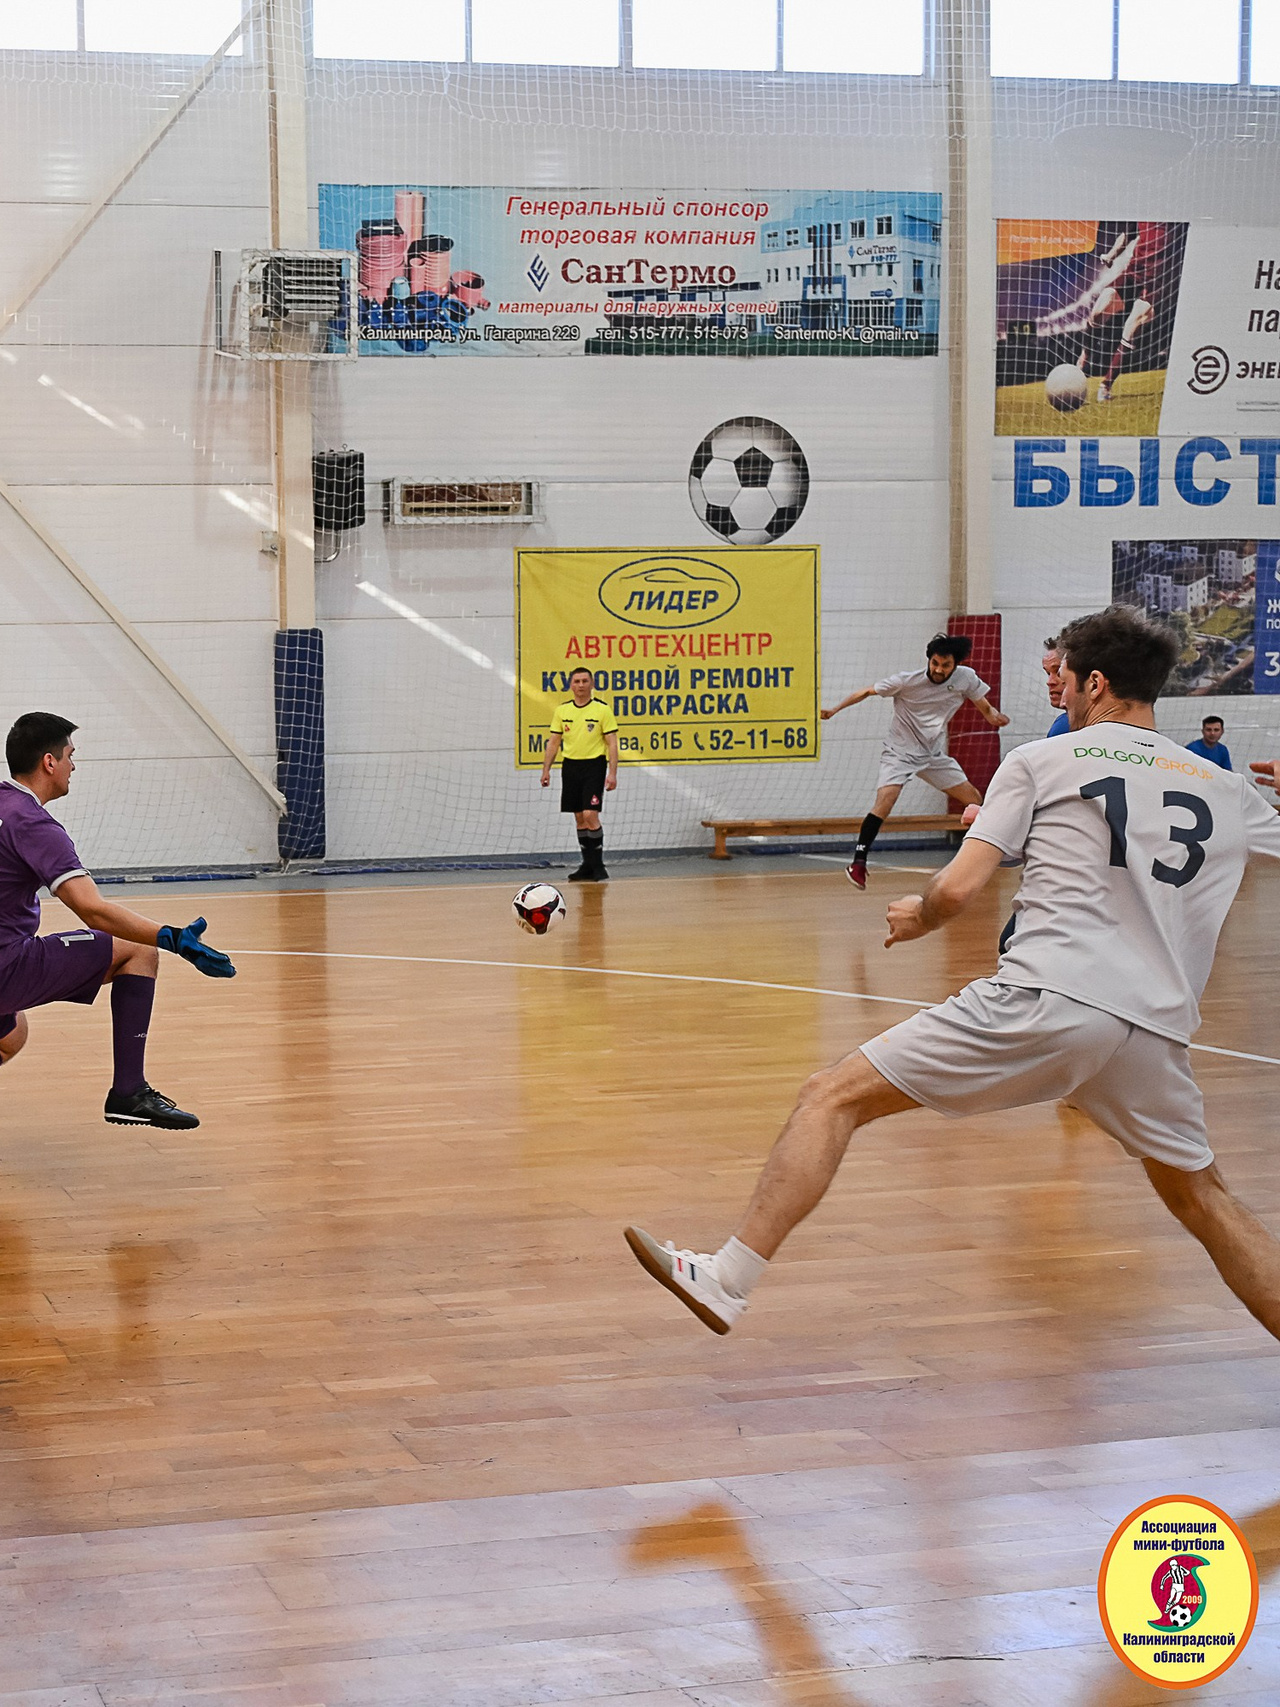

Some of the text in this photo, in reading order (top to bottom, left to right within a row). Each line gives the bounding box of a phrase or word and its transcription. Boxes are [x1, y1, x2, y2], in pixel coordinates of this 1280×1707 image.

[506, 196, 770, 220] Генеральный спонсор
[520, 228, 756, 248] торговая компания
[561, 258, 737, 291] СанТермо
[498, 298, 778, 317] материалы для наружных сетей
[485, 326, 551, 342] Гагарина
[553, 326, 580, 341] 229
[597, 327, 625, 341] тел.
[628, 326, 690, 342] 515-777,
[693, 326, 749, 341] 515-073
[773, 326, 919, 344] Santermo-KL@mail.ru
[1248, 309, 1280, 340] па
[1235, 361, 1280, 379] ЭНЕ
[1014, 436, 1280, 507] БЫСТ
[624, 589, 719, 613] ЛИДЕР
[565, 632, 774, 661] АВТОТЕХЦЕНТР
[541, 664, 795, 692] КУОВНОЙ РЕМОНТ
[613, 693, 749, 717] ПОКРАСКА
[649, 730, 683, 750] 61Б
[709, 727, 808, 750] 52-11-68
[1073, 747, 1214, 781] DOLGOVGROUP
[1079, 775, 1214, 889] 13
[60, 932, 95, 947] 1
